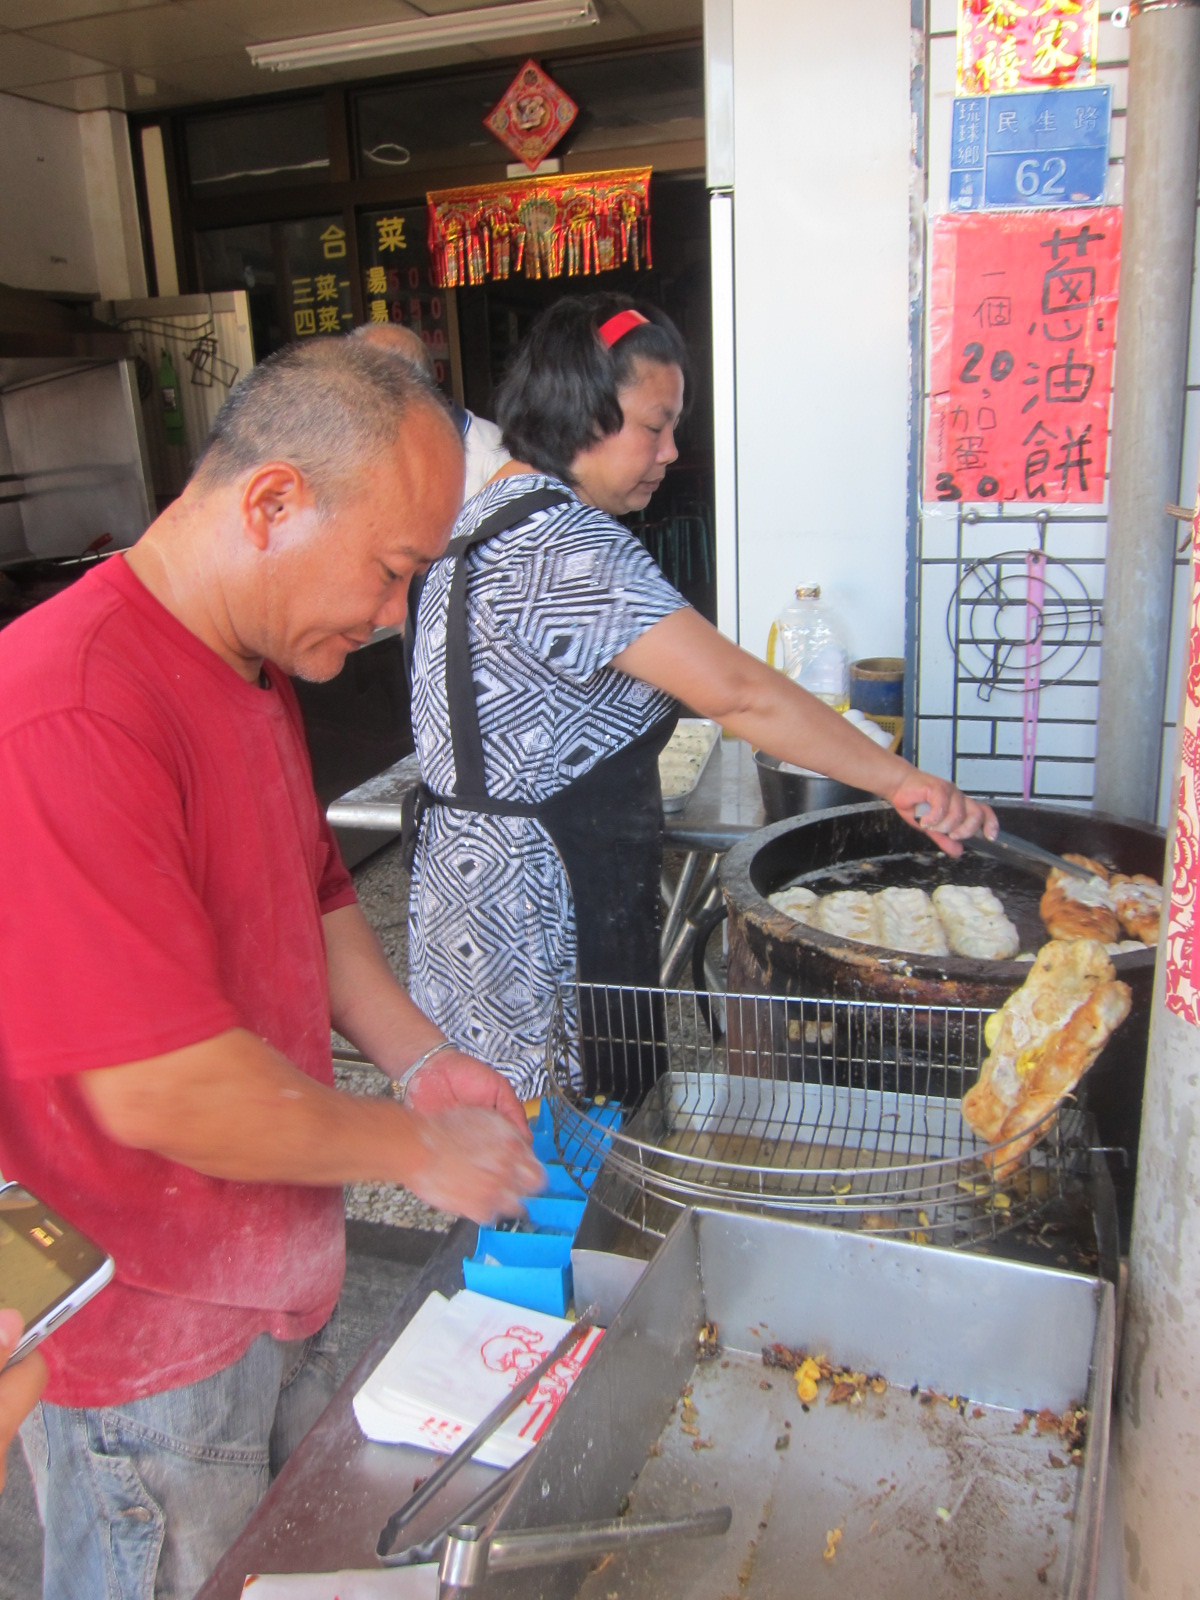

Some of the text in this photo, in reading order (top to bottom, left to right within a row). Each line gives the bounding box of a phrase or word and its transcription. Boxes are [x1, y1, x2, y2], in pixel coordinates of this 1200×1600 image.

[1030, 0, 1083, 76] 家
[958, 101, 981, 165] 琉球鄉
[997, 107, 1100, 134] 民生路
[1015, 157, 1067, 197] 62
